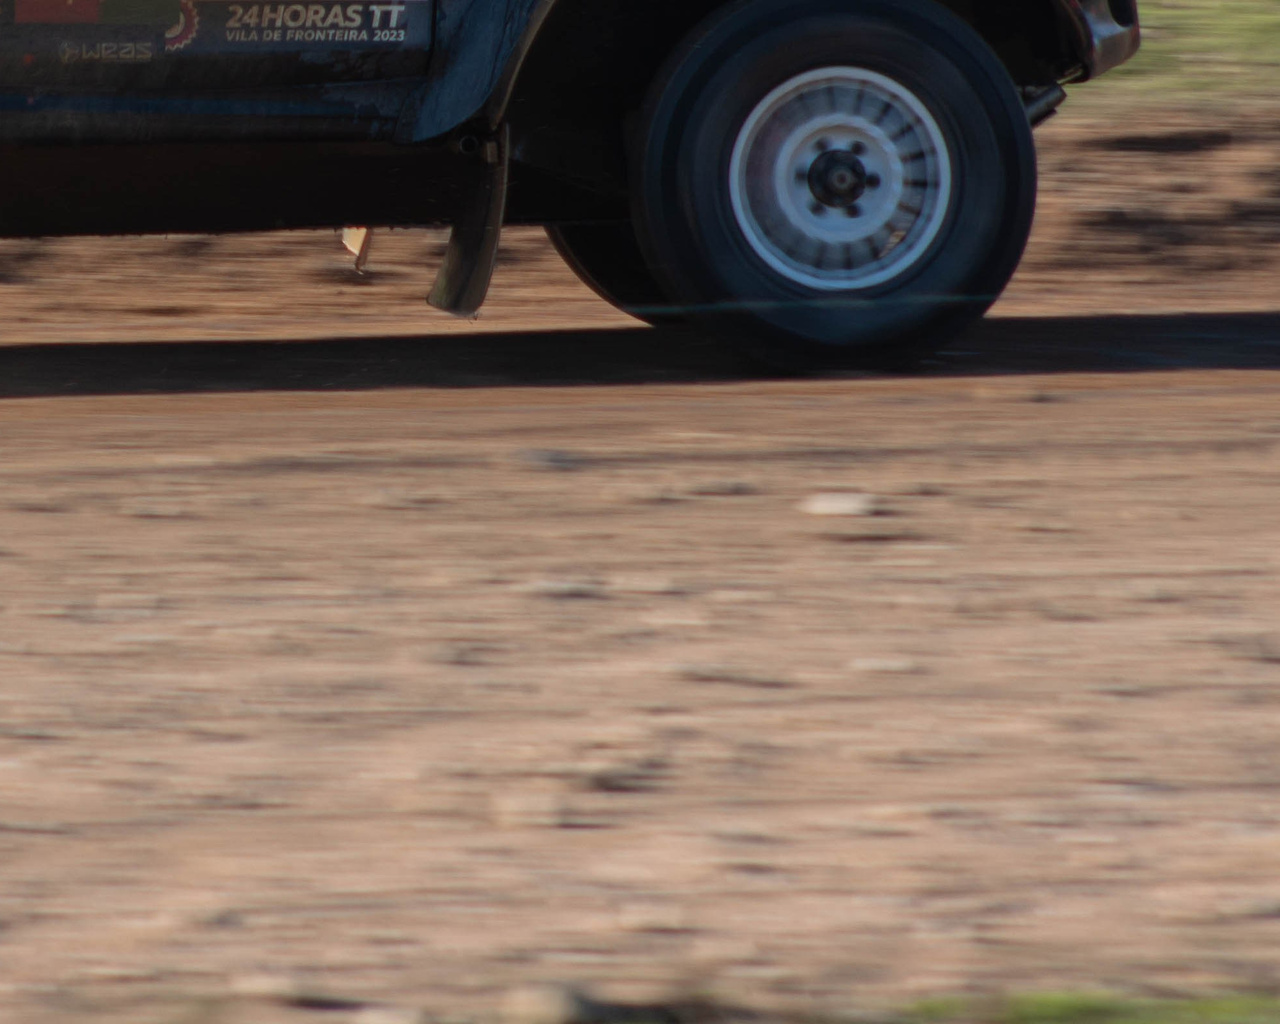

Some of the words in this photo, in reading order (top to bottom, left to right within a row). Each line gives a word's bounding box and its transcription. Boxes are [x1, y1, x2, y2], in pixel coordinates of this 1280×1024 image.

[369, 5, 406, 28] TT
[225, 30, 258, 41] VILA
[262, 30, 282, 41] DE
[286, 30, 368, 41] FRONTEIRA
[373, 30, 406, 41] 2023
